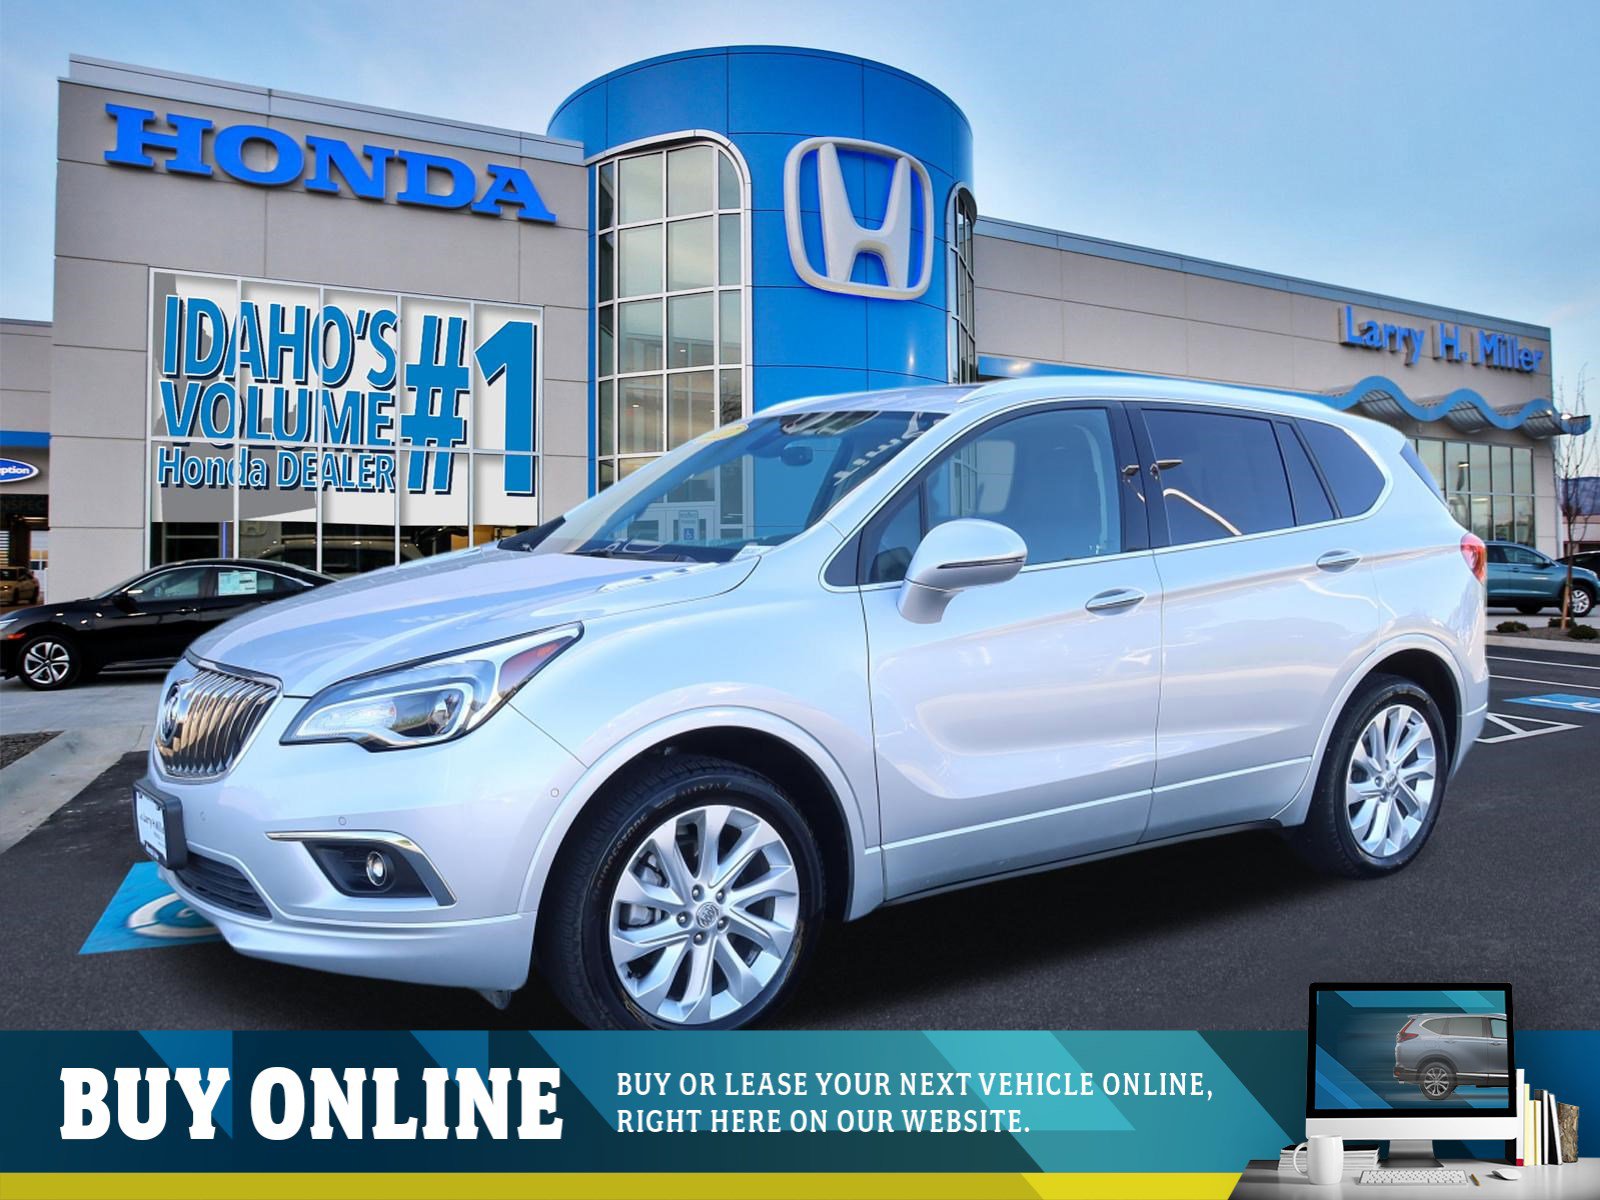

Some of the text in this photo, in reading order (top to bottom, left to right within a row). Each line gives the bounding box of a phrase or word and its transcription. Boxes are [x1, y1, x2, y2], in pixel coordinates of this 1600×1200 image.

[104, 103, 558, 224] HONDA
[162, 295, 399, 390] IDAHO'S
[1340, 304, 1544, 374] Larry H. Miller
[158, 379, 397, 449] VOLUME
[400, 314, 541, 497] #1
[0, 465, 30, 476] ption
[156, 446, 397, 492] Honda DEALER
